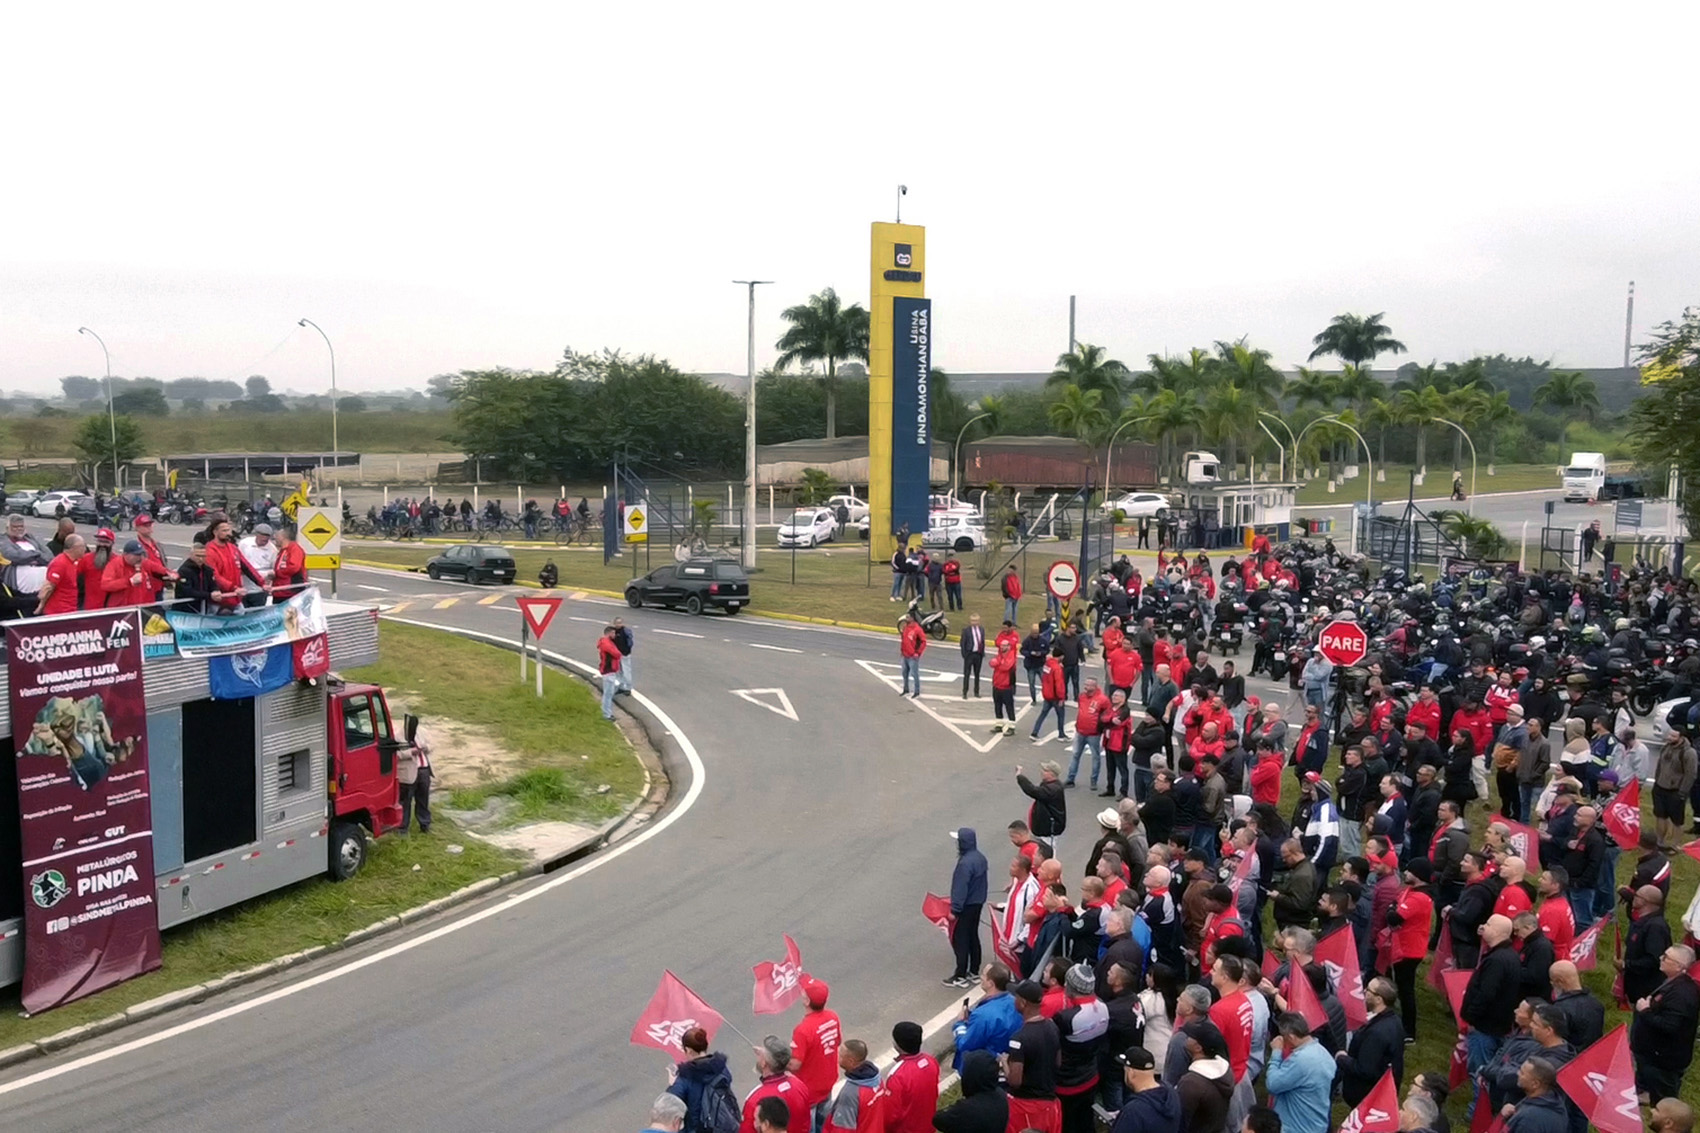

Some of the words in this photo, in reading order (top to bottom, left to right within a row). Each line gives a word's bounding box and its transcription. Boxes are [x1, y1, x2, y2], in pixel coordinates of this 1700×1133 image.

[909, 309, 919, 344] USINA
[917, 308, 929, 445] PINDAMONHANGABA
[32, 629, 104, 649] CAMPANHA
[46, 641, 105, 660] SALARIAL
[1322, 635, 1363, 652] PARE
[36, 668, 84, 685] UNIDADE
[83, 667, 92, 678] E
[92, 663, 119, 676] LUTA
[77, 850, 138, 875] METALÚRGICOS
[77, 864, 139, 897] PINDA
